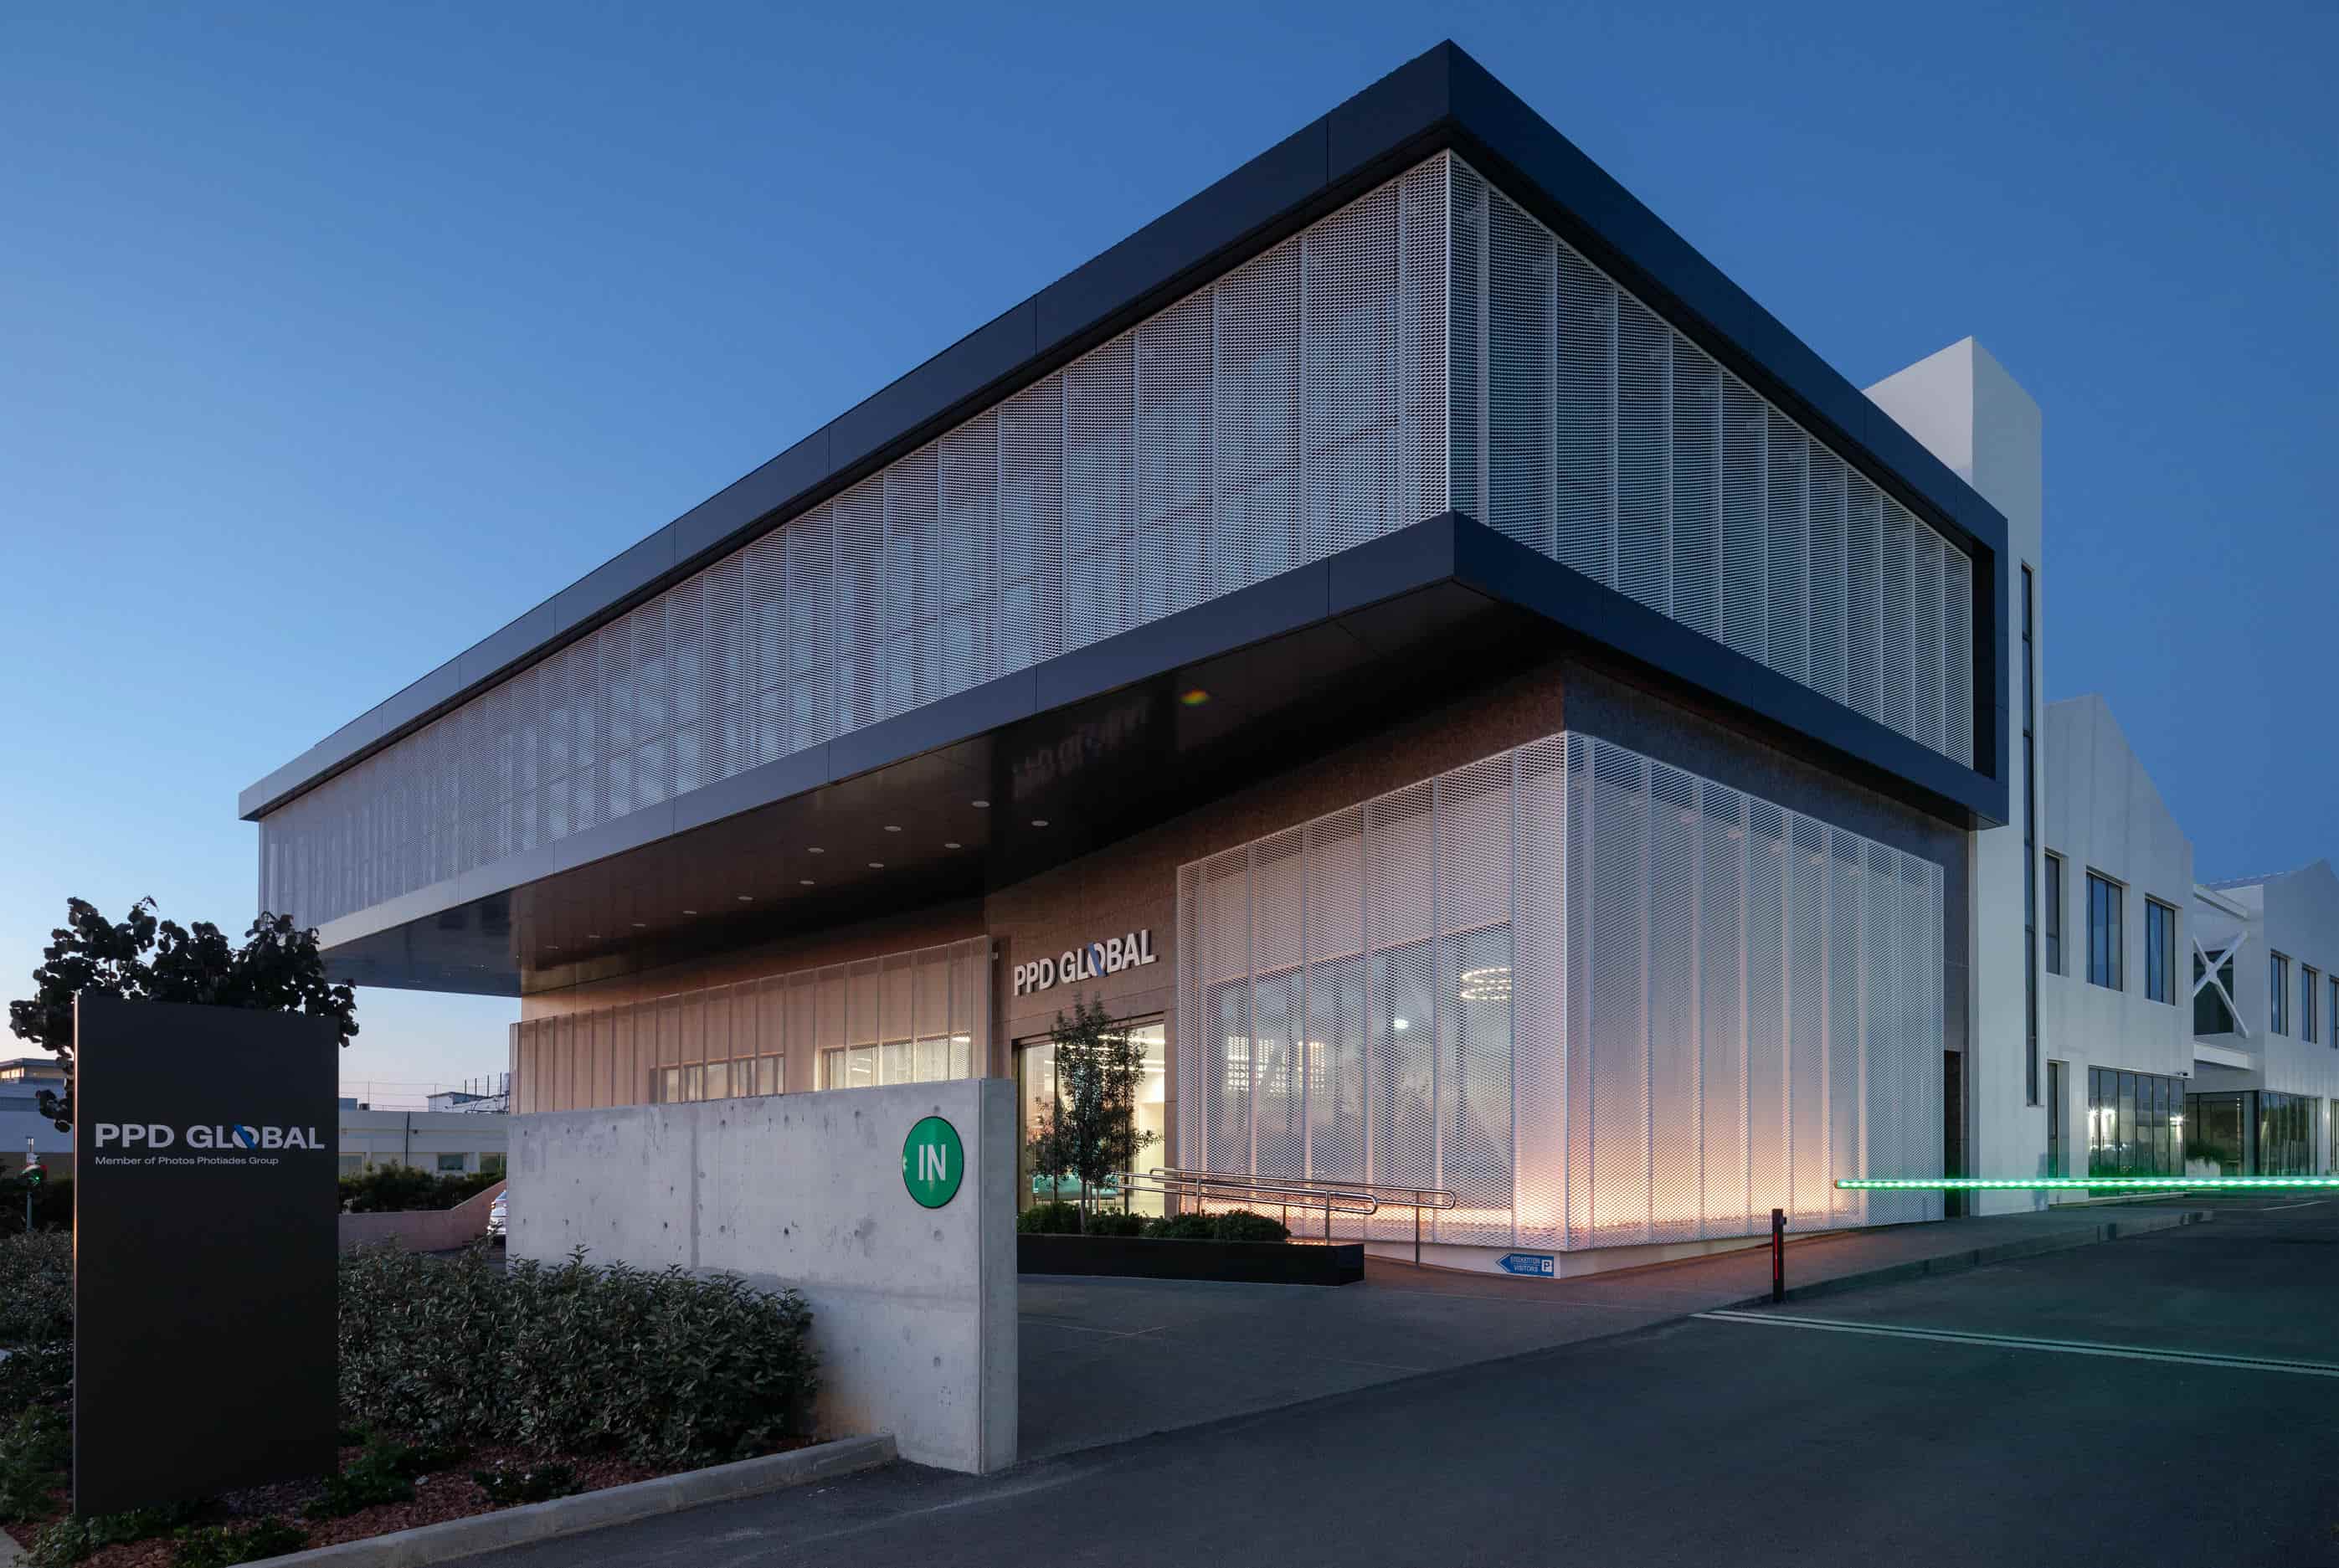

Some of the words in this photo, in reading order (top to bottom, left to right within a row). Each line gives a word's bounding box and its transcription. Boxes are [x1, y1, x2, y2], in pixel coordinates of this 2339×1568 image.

[1014, 958, 1054, 995] PPD
[1059, 929, 1156, 984] GLOBAL
[95, 1123, 175, 1148] PPD
[186, 1124, 325, 1149] GLOBAL
[95, 1156, 142, 1165] Member
[144, 1156, 156, 1165] of
[158, 1156, 195, 1165] Photos
[197, 1156, 247, 1165] Photiades
[249, 1156, 279, 1166] Group
[918, 1144, 947, 1181] IN
[1514, 1265, 1539, 1273] VISITORS
